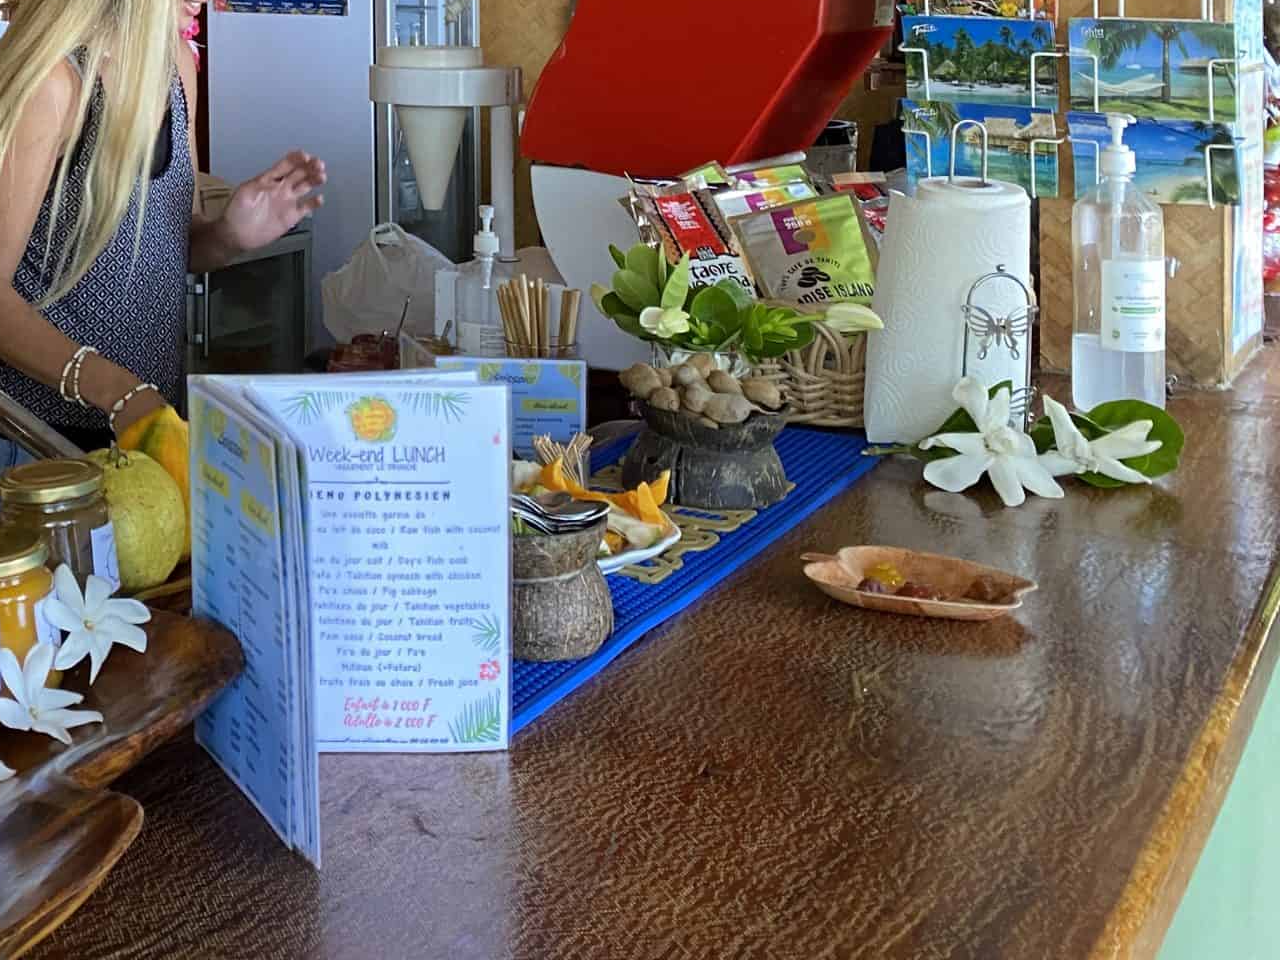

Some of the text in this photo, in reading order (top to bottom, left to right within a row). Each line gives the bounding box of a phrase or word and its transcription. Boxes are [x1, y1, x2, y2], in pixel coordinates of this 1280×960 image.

[834, 282, 874, 297] ISLAND
[392, 447, 446, 463] LUNCH
[404, 601, 440, 610] Tahitian
[408, 616, 444, 626] Tahitian
